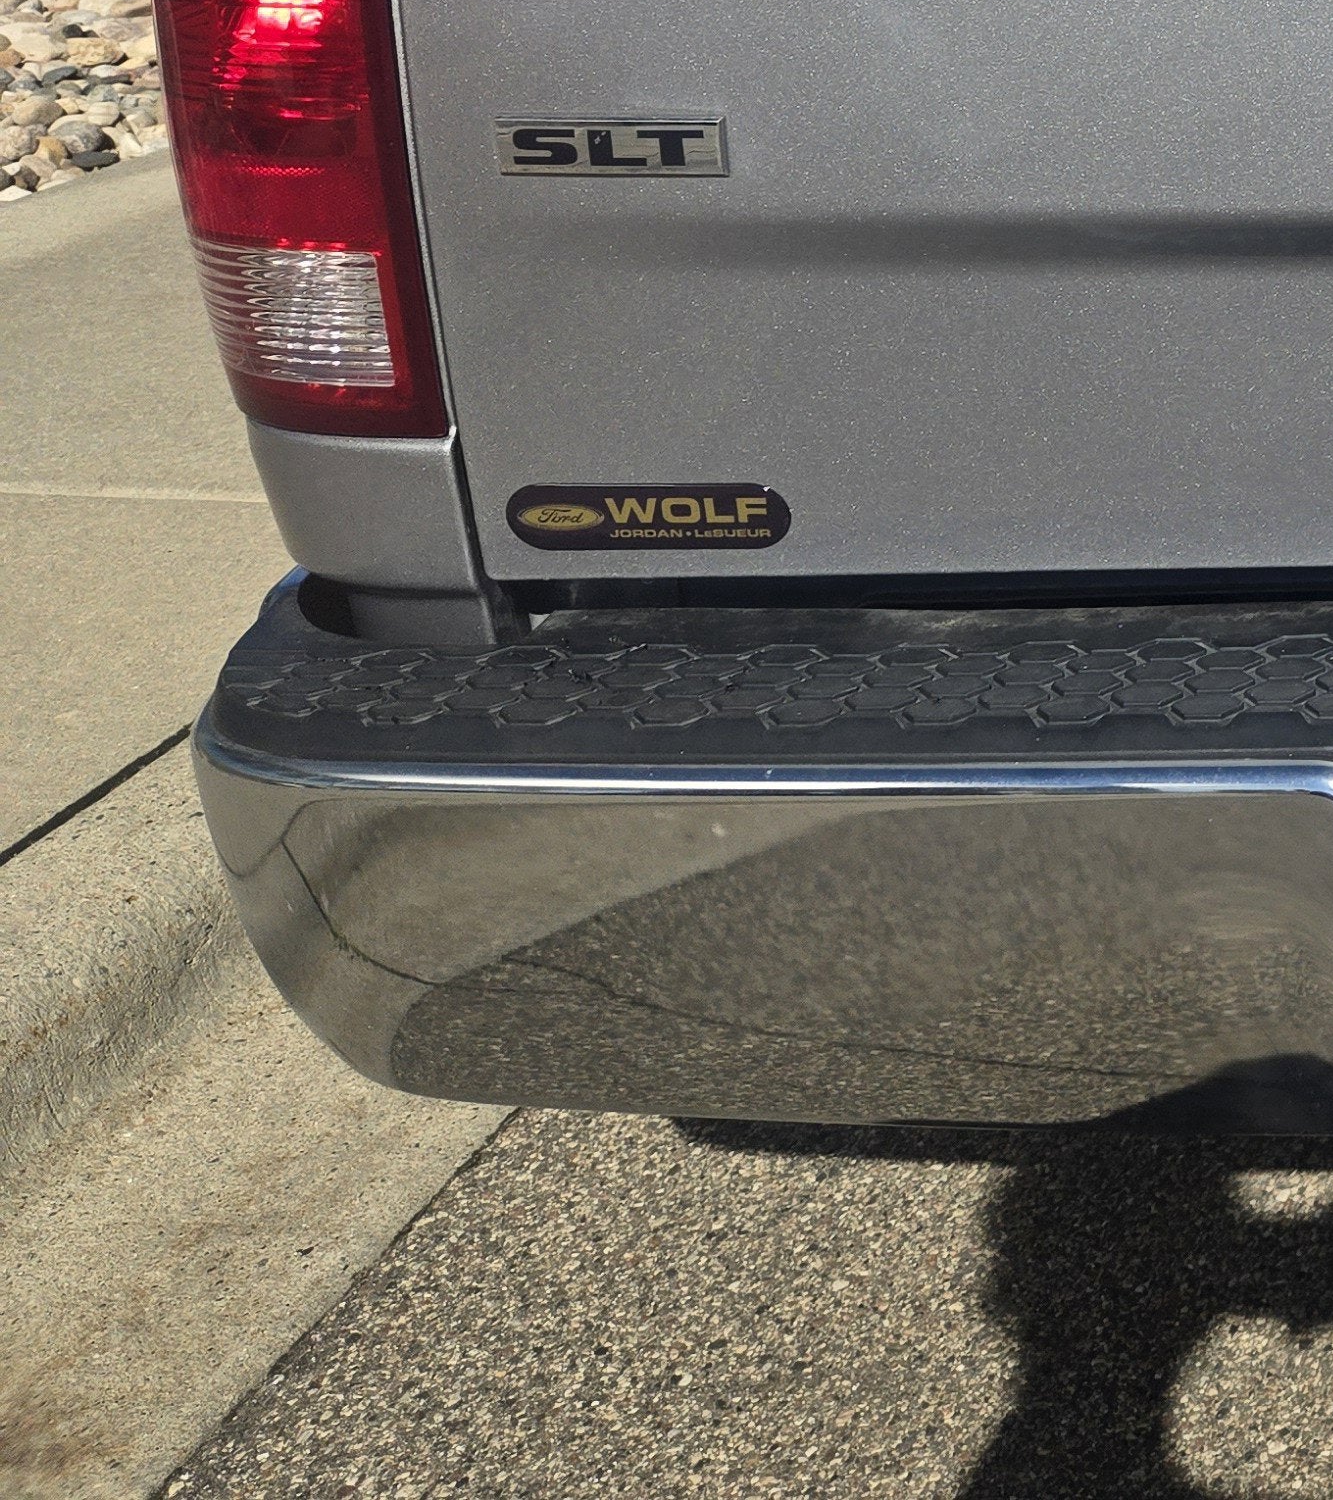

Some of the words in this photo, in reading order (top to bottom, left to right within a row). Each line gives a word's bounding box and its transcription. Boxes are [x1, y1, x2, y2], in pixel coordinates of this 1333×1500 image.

[512, 129, 704, 166] SLT
[537, 508, 584, 524] Ford
[604, 498, 768, 523] WOLF
[610, 529, 683, 538] JORDAN
